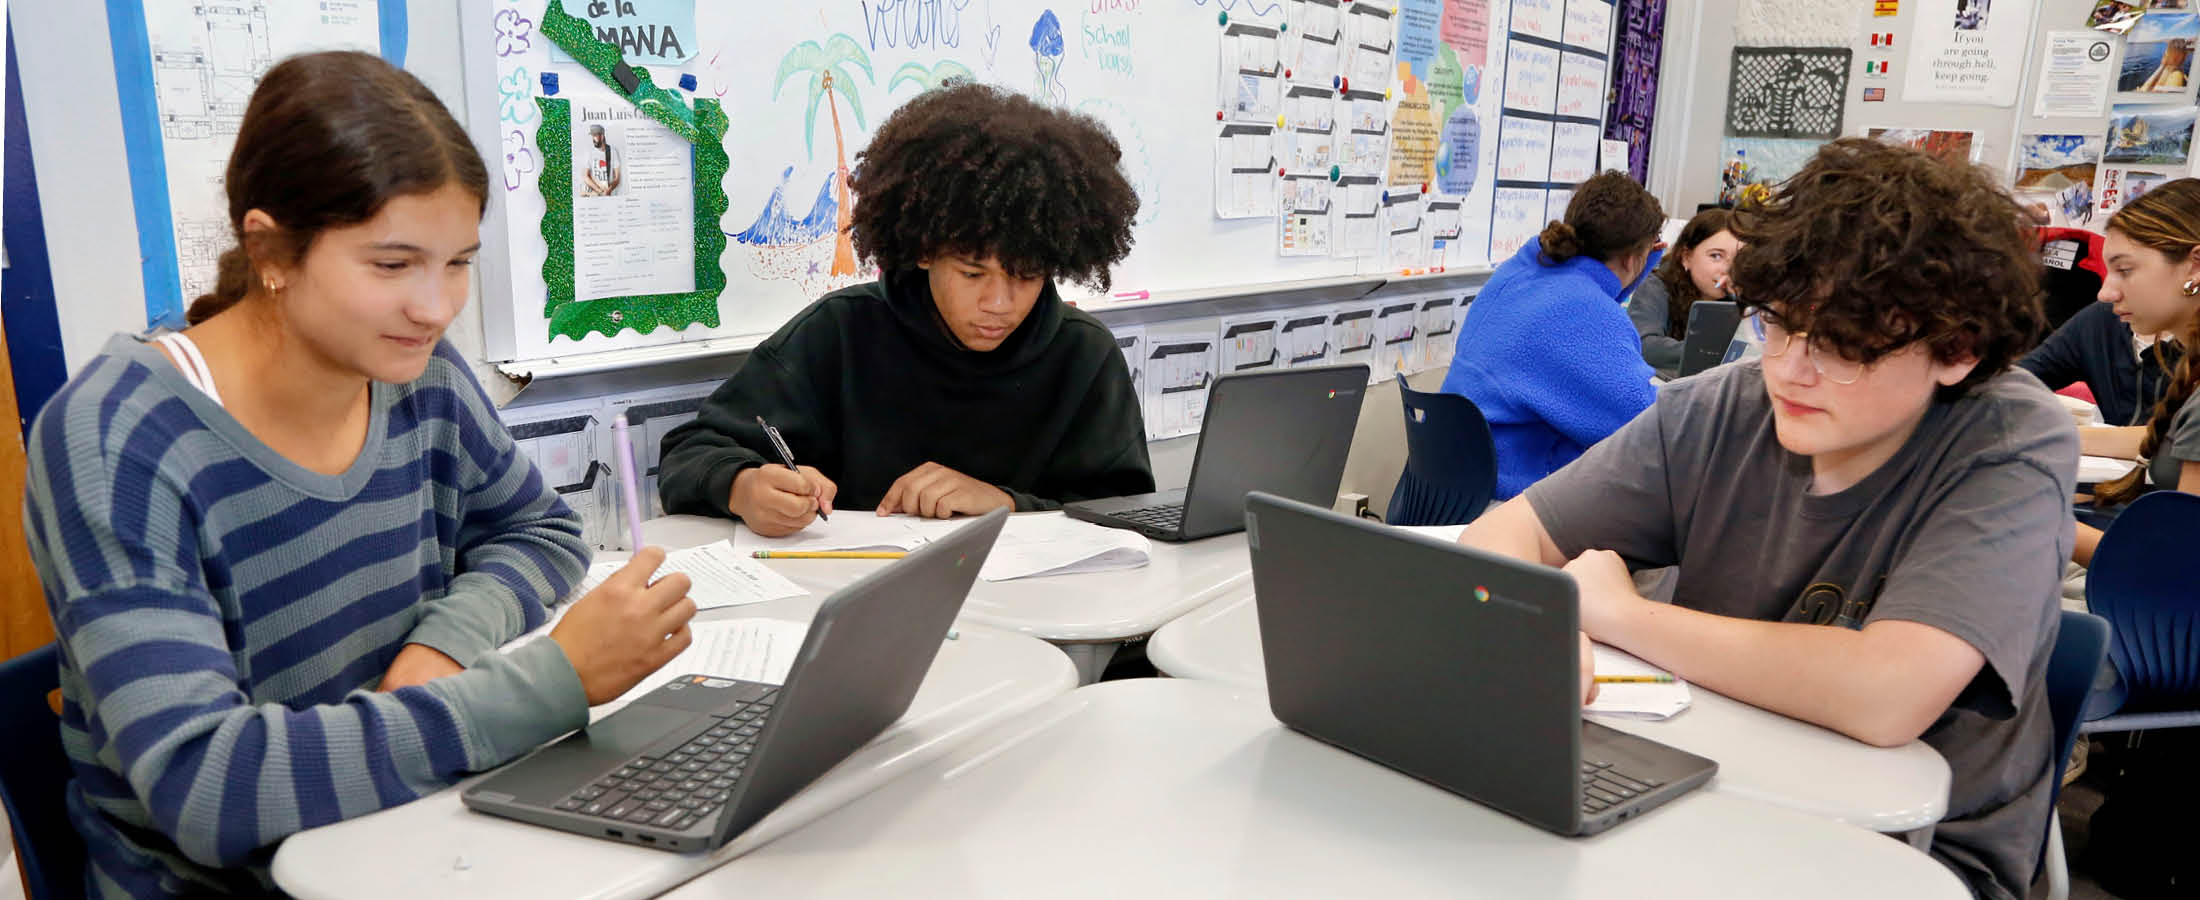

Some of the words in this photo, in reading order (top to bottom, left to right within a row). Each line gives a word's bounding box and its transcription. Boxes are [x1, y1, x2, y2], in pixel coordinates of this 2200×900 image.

[587, 0, 610, 18] de
[615, 0, 637, 18] la
[1966, 35, 1984, 46] you
[1961, 47, 1989, 58] going
[1932, 59, 1972, 70] through
[581, 106, 607, 122] Juan
[609, 106, 633, 121] Luis
